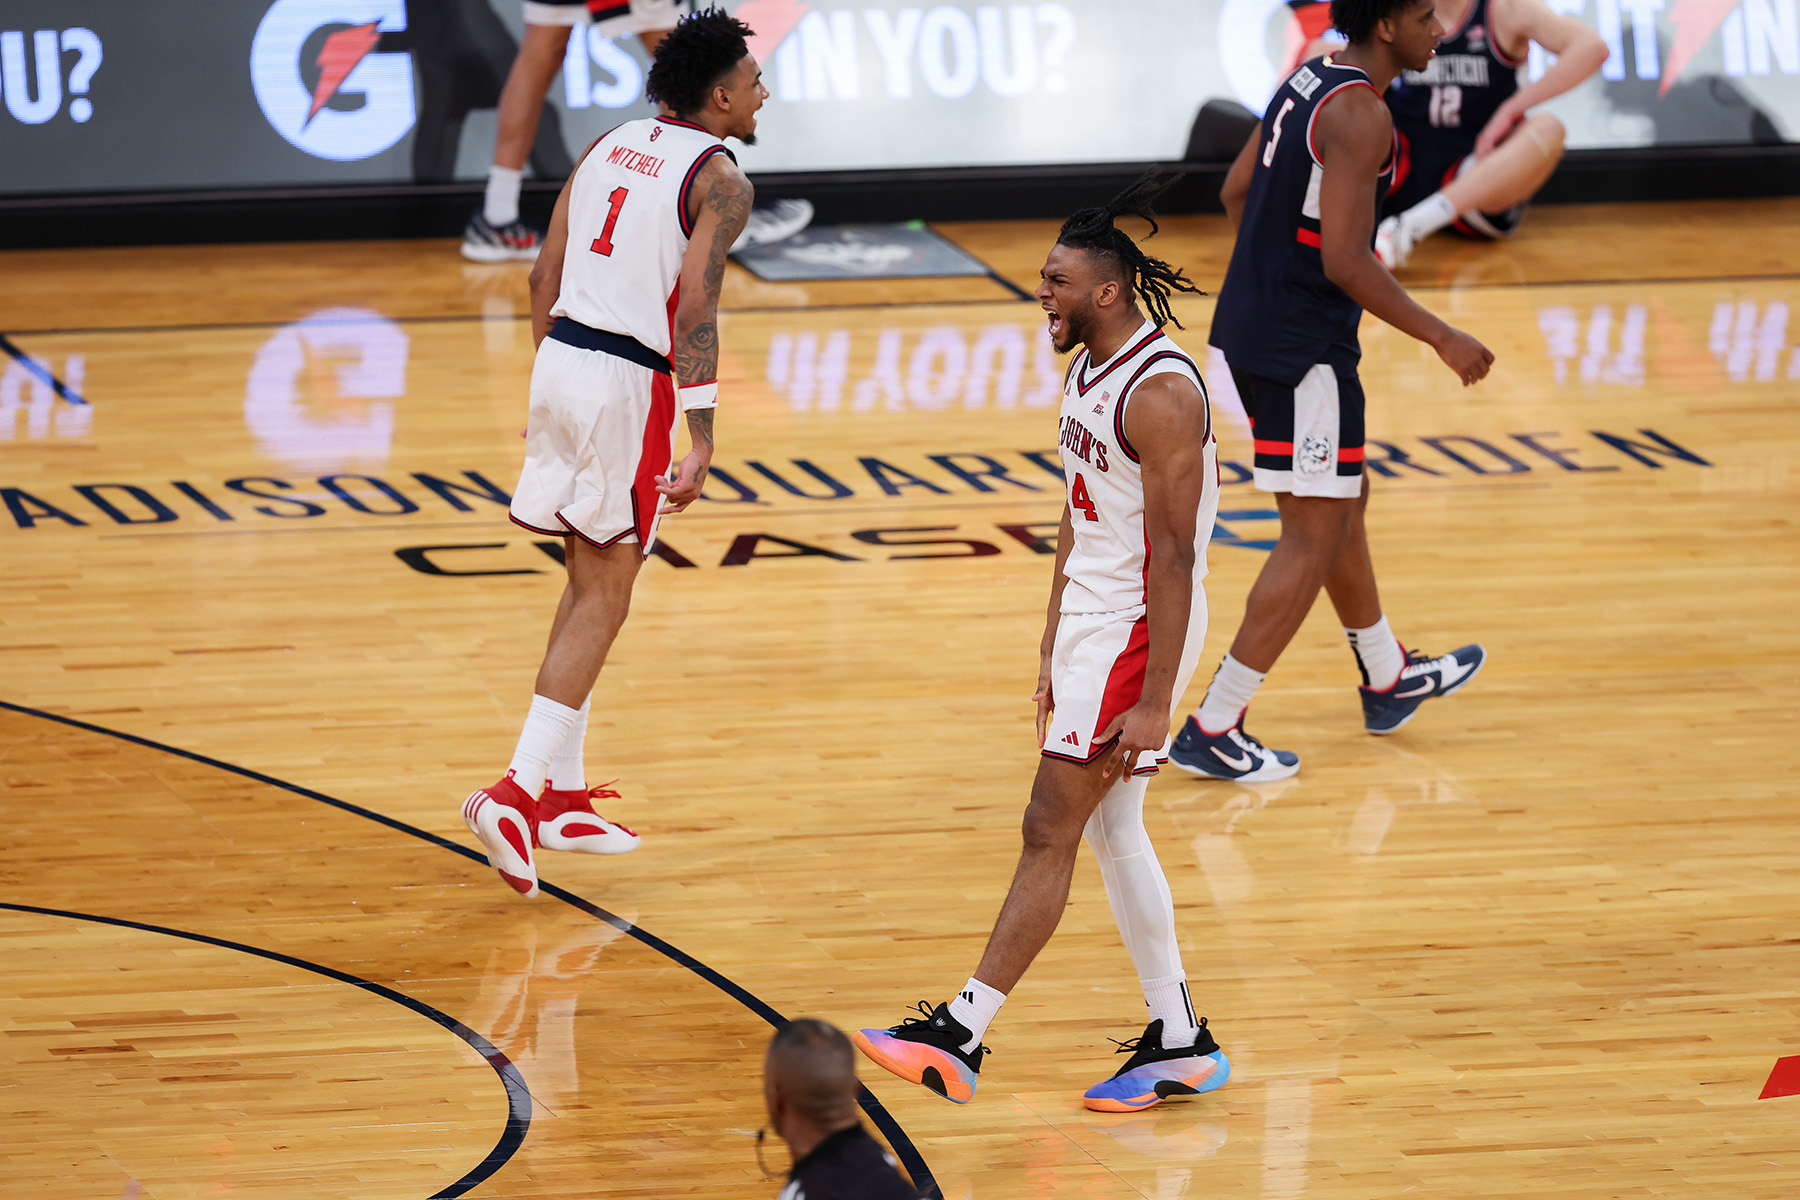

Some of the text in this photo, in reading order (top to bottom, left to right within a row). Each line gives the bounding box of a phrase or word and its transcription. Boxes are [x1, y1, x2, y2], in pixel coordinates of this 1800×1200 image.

[0, 27, 103, 125] U?
[563, 20, 642, 109] IS
[774, 2, 1078, 102] IN YOU?
[1262, 97, 1295, 168] 5
[1429, 85, 1463, 129] 12
[605, 145, 666, 178] MITCHELL
[590, 186, 629, 257] 1
[671, 449, 1065, 505] QUAR
[1219, 428, 1715, 484] RDEN
[1061, 416, 1109, 473] JOHN'S
[1064, 472, 1099, 522] 4
